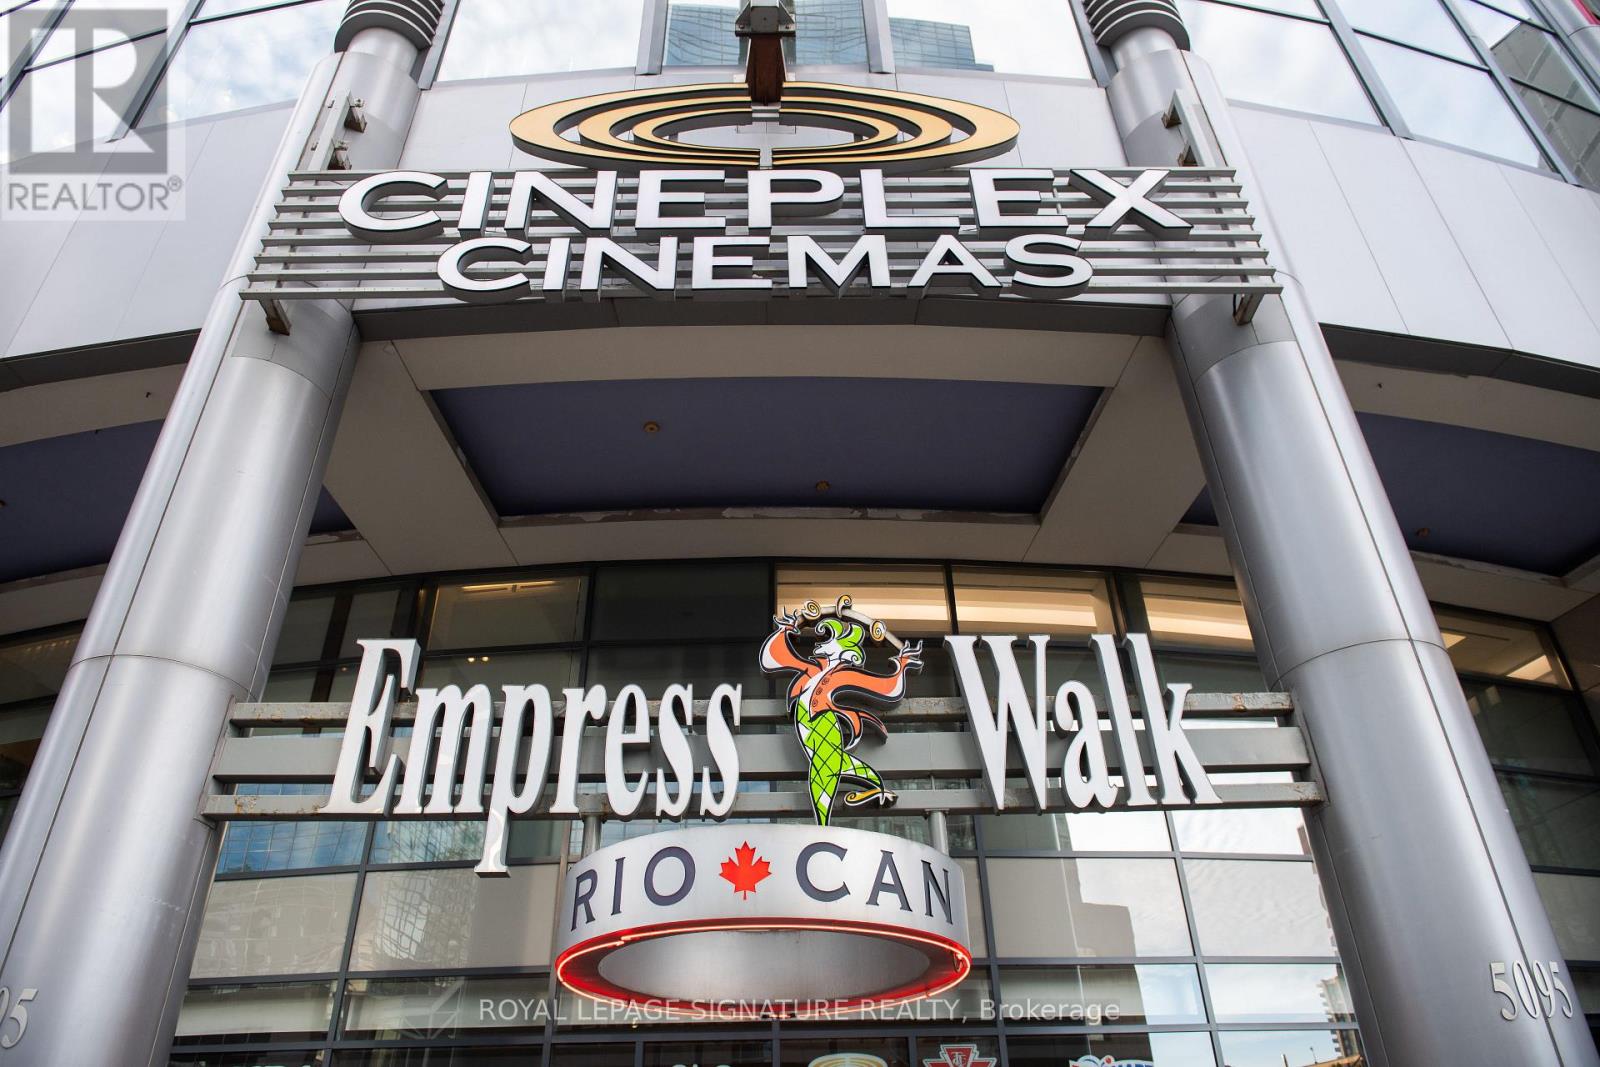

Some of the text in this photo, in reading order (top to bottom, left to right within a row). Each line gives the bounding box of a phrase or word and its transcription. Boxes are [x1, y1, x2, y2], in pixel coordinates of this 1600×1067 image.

[338, 169, 1194, 242] CINEPLEX
[437, 233, 1094, 295] CINEMAS
[316, 632, 1223, 876] Empress Walk
[570, 841, 954, 932] RIO CAN
[1489, 960, 1573, 1021] 5095
